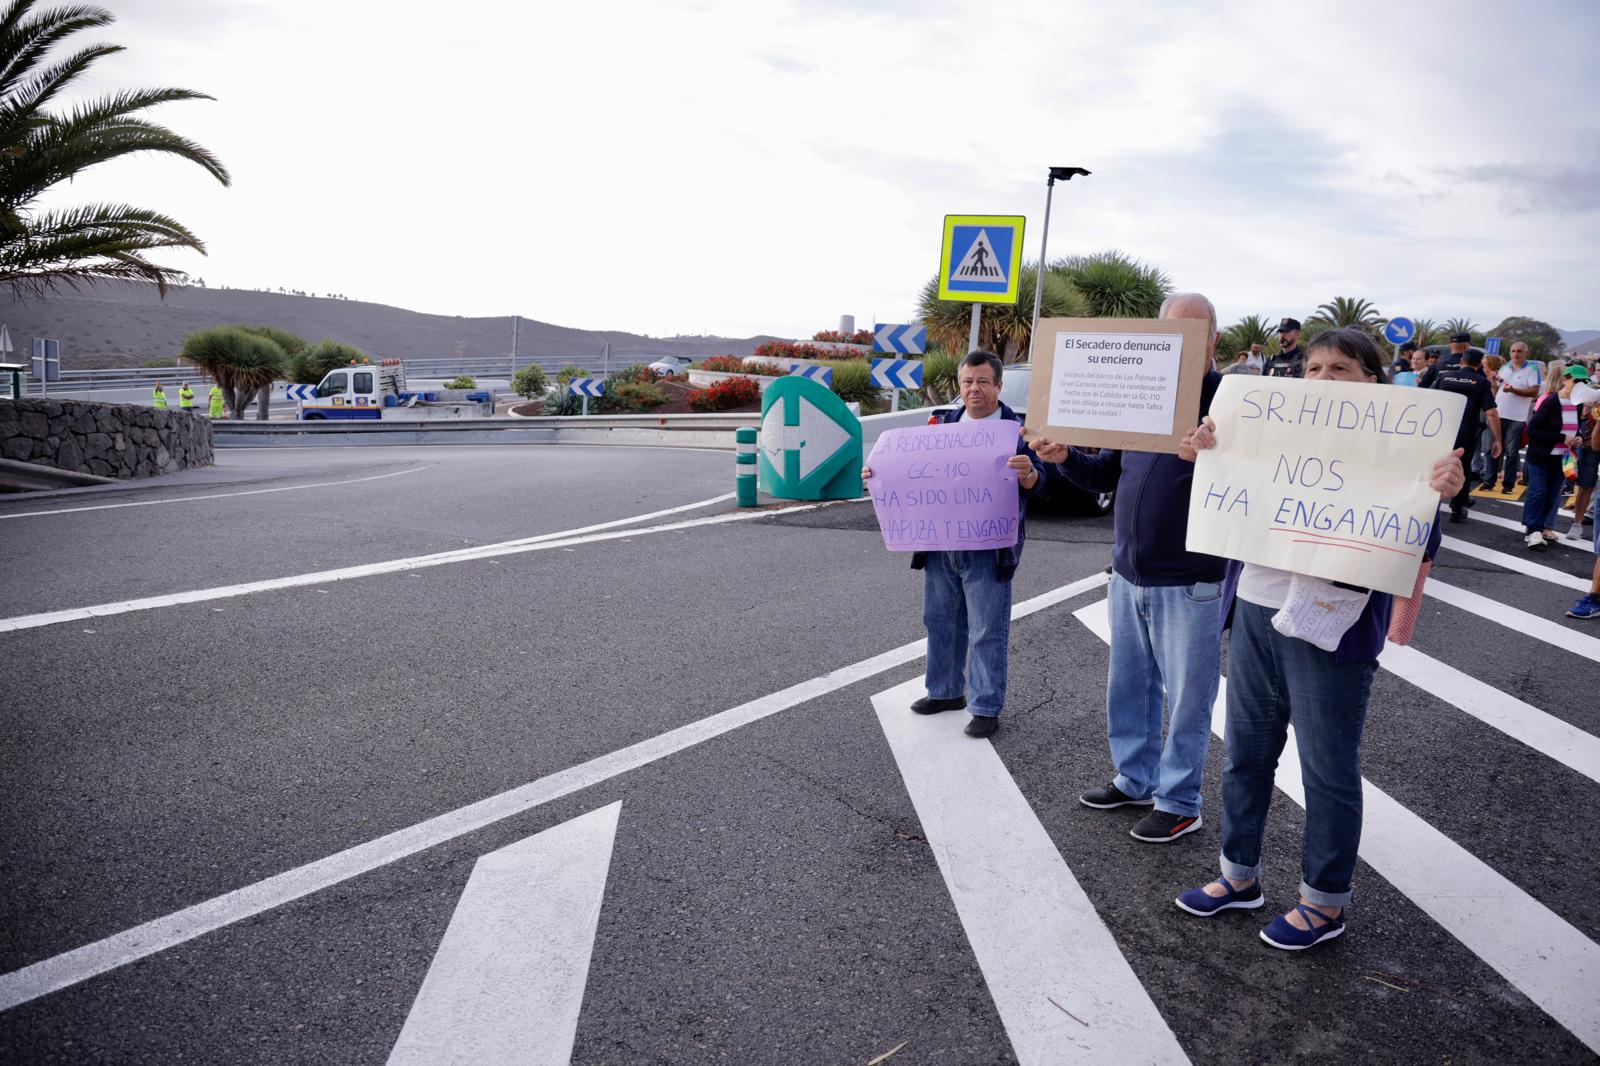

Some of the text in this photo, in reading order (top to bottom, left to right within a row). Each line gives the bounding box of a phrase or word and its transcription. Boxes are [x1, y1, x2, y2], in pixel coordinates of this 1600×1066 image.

[1065, 339, 1171, 352] El Secadero denuncia
[1088, 355, 1143, 365] su encierro
[1135, 374, 1157, 382] Palmas
[1138, 393, 1161, 401] GC-110
[896, 427, 995, 452] REORDENACIÓN
[907, 462, 971, 479] GC-110
[1272, 454, 1344, 491] NOS
[874, 488, 901, 507] HA
[906, 489, 948, 506] SIDO
[1204, 483, 1431, 547] HA ENGAÑADO
[942, 518, 952, 540] Y
